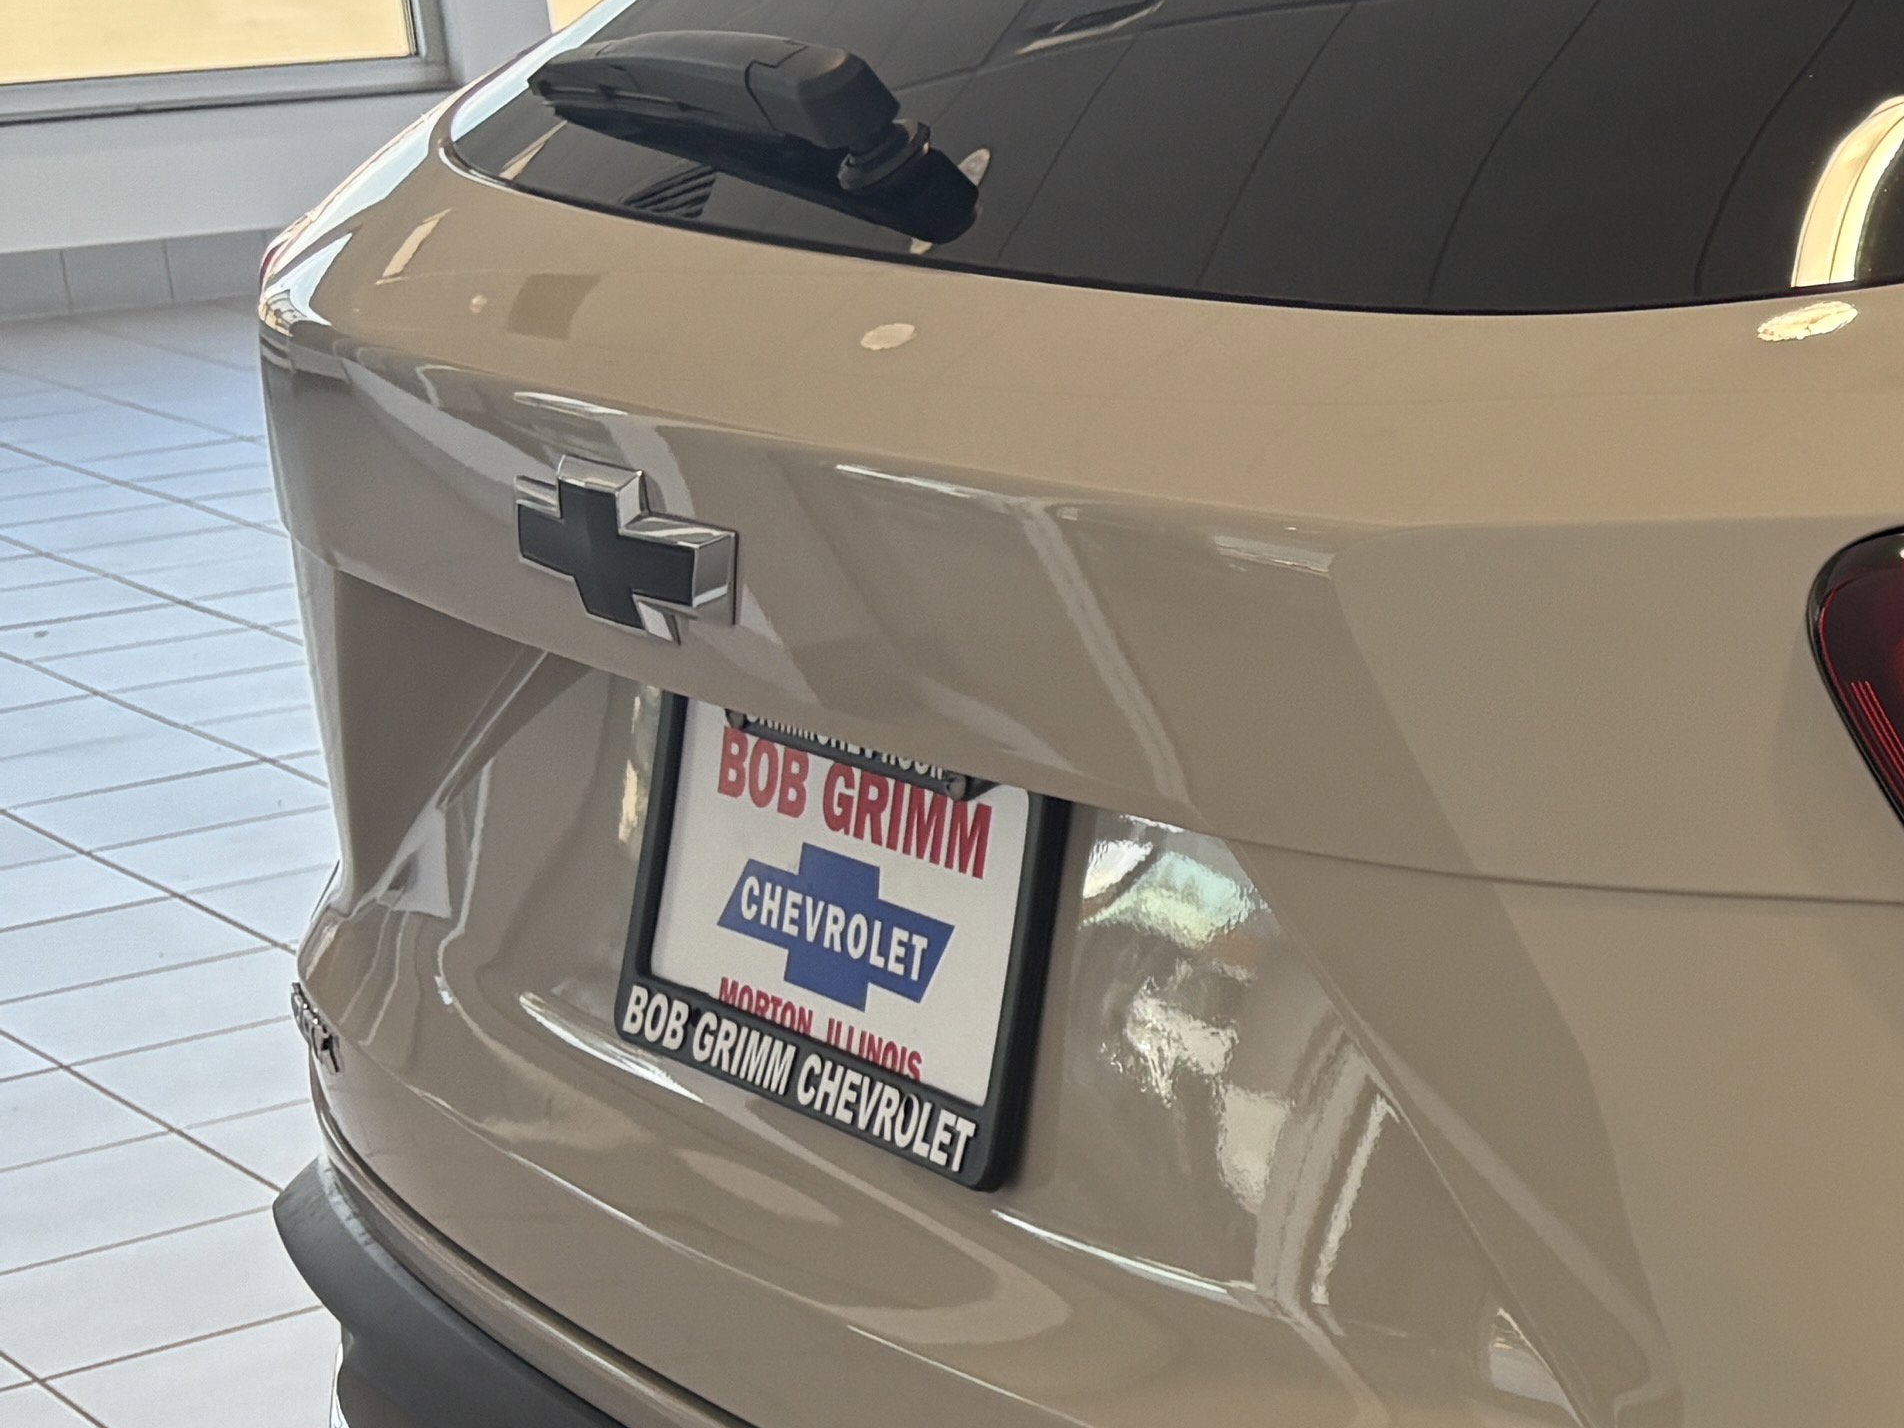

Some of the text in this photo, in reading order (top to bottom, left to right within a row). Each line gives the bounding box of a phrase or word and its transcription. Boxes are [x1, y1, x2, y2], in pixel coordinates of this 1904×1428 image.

[717, 724, 810, 819] BOB
[823, 762, 993, 880] GRIMM
[741, 875, 929, 982] CHEVROLET
[622, 984, 976, 1173] BOB GRIMM CHEVROLET
[826, 1017, 922, 1082] ILLINOIS
